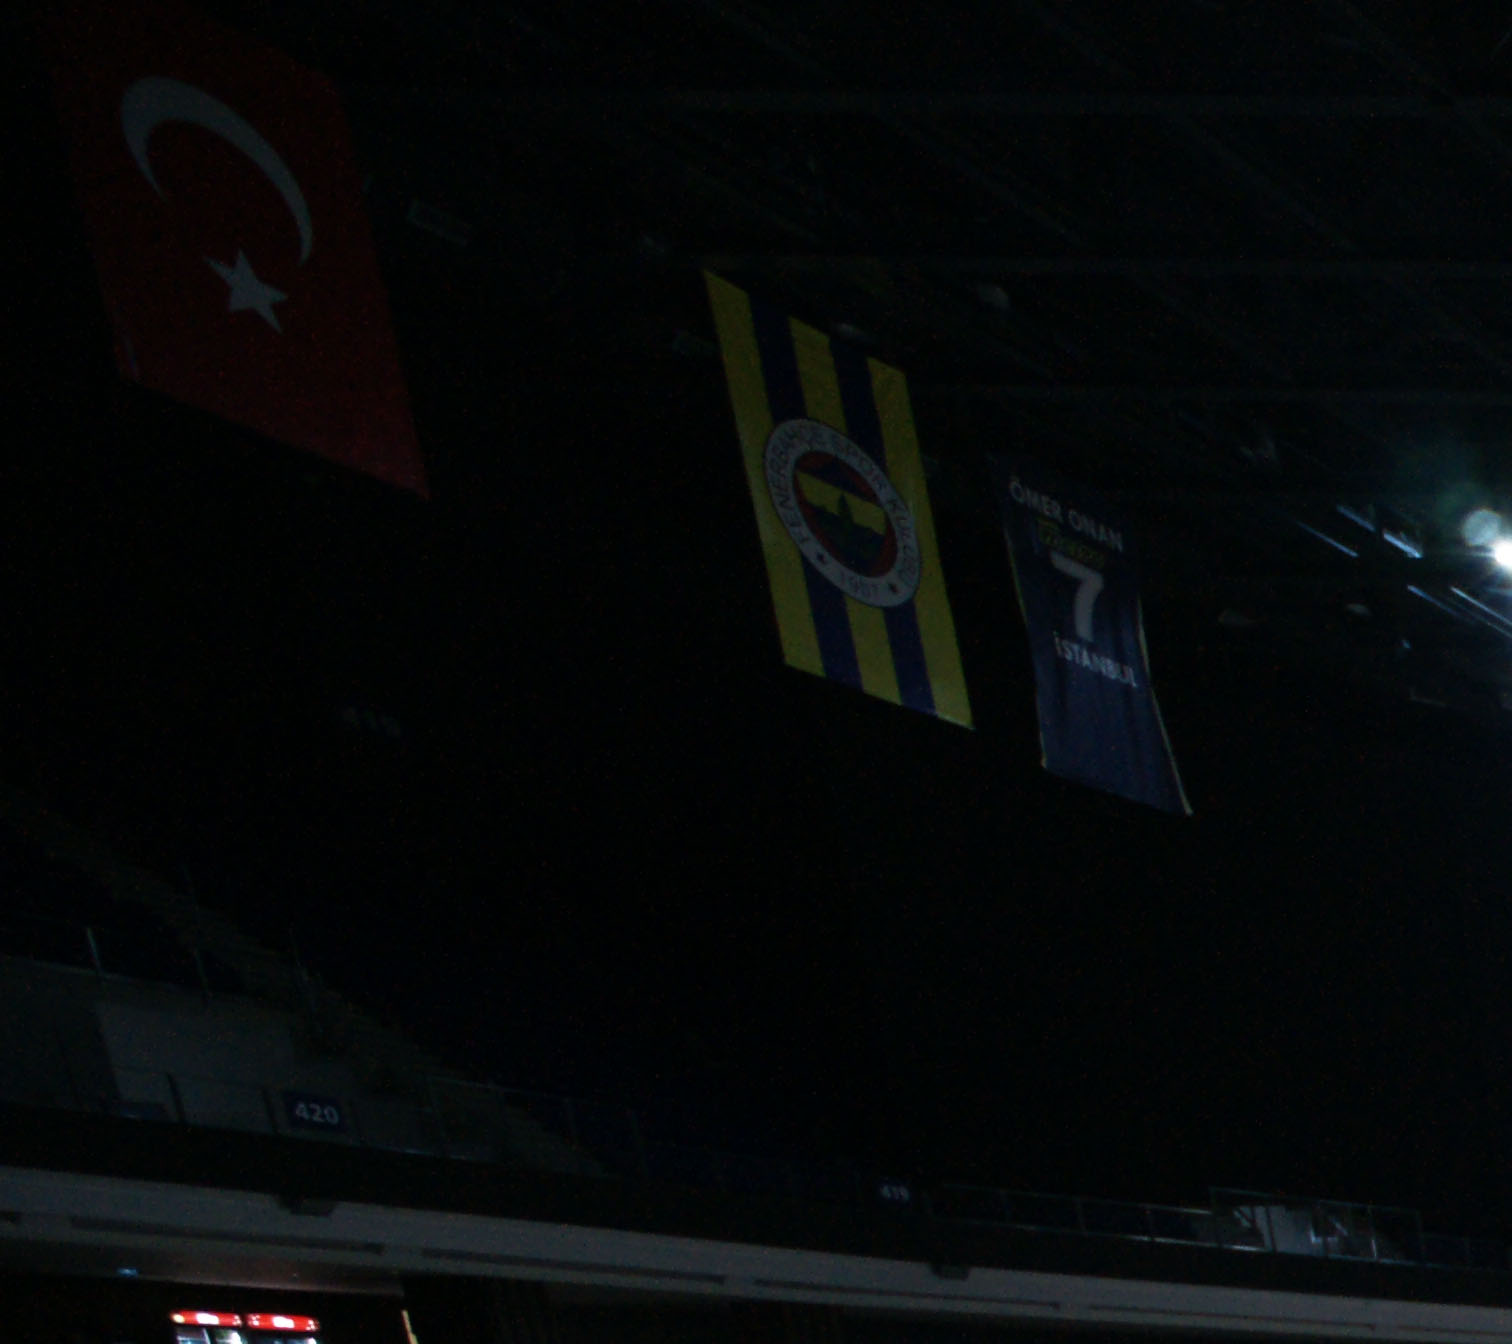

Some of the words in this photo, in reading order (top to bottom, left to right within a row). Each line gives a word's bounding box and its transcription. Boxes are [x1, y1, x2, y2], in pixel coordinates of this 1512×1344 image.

[1009, 475, 1065, 524] ÖMER
[1068, 508, 1125, 553] ONAN
[1049, 549, 1105, 644] 7
[295, 1101, 339, 1125] 420
